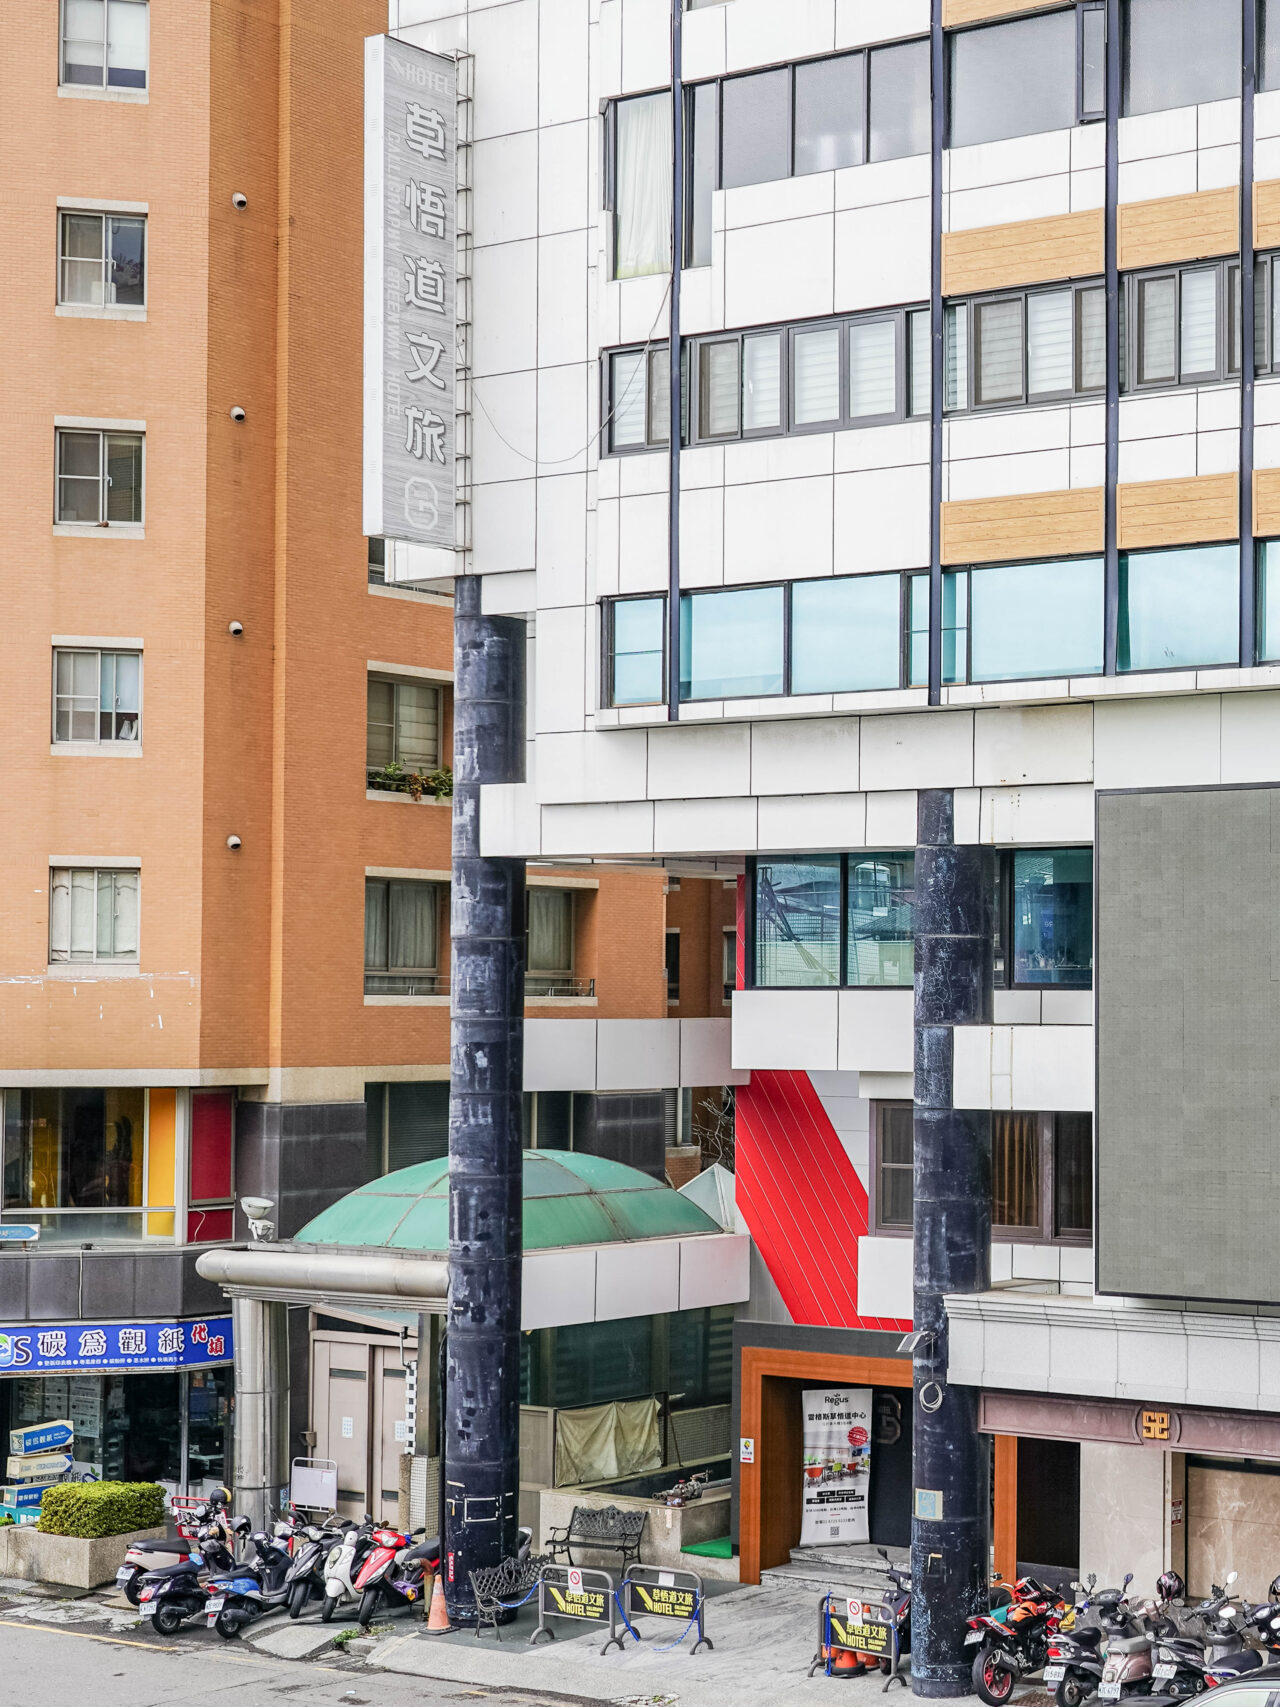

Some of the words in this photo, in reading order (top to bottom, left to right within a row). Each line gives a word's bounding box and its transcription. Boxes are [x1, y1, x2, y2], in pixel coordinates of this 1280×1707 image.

[403, 101, 447, 465] 草悟道文旅
[824, 1393, 849, 1406] Regus
[567, 1603, 586, 1616] HOTEL
[653, 1602, 674, 1615] HOTEL
[847, 1635, 867, 1649] HOTEL
